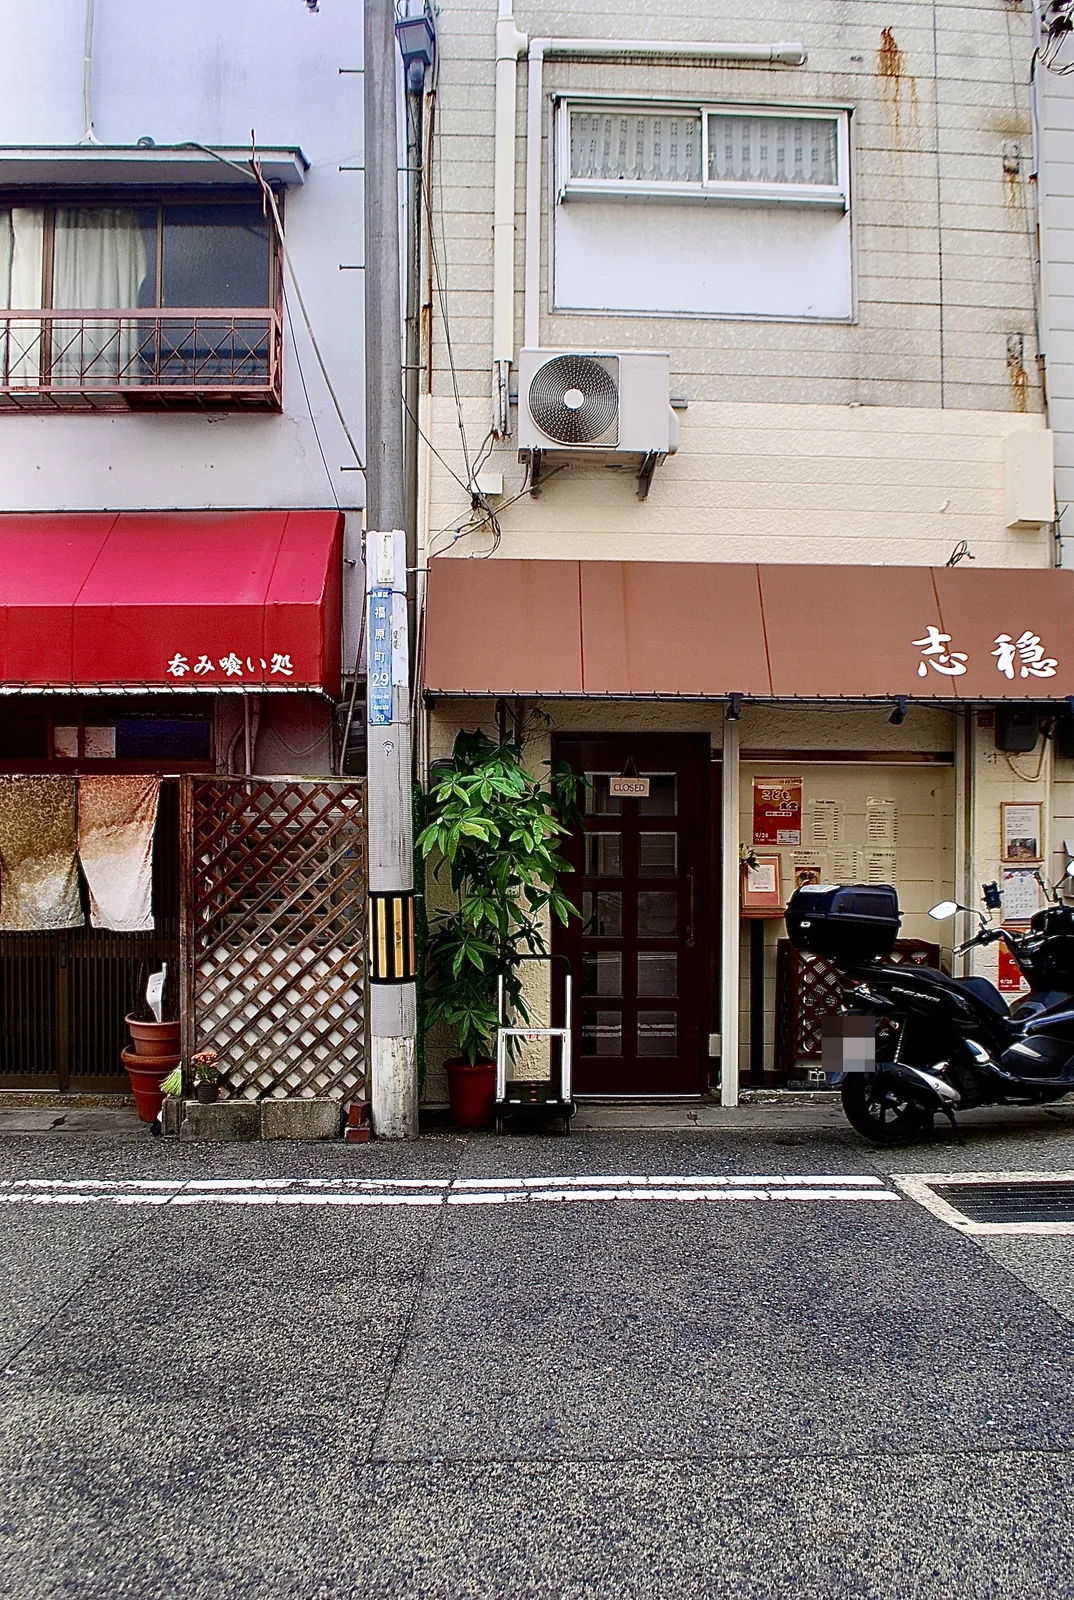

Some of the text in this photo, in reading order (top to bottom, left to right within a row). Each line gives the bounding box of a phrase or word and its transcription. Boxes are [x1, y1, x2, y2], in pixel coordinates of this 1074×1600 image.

[374, 606, 386, 663] 福原町
[166, 652, 294, 677] 呑み喰い処
[372, 673, 389, 687] 29
[375, 714, 385, 722] 29
[613, 783, 646, 792] CLOSED
[761, 789, 791, 800] こども
[779, 801, 798, 811] 食堂
